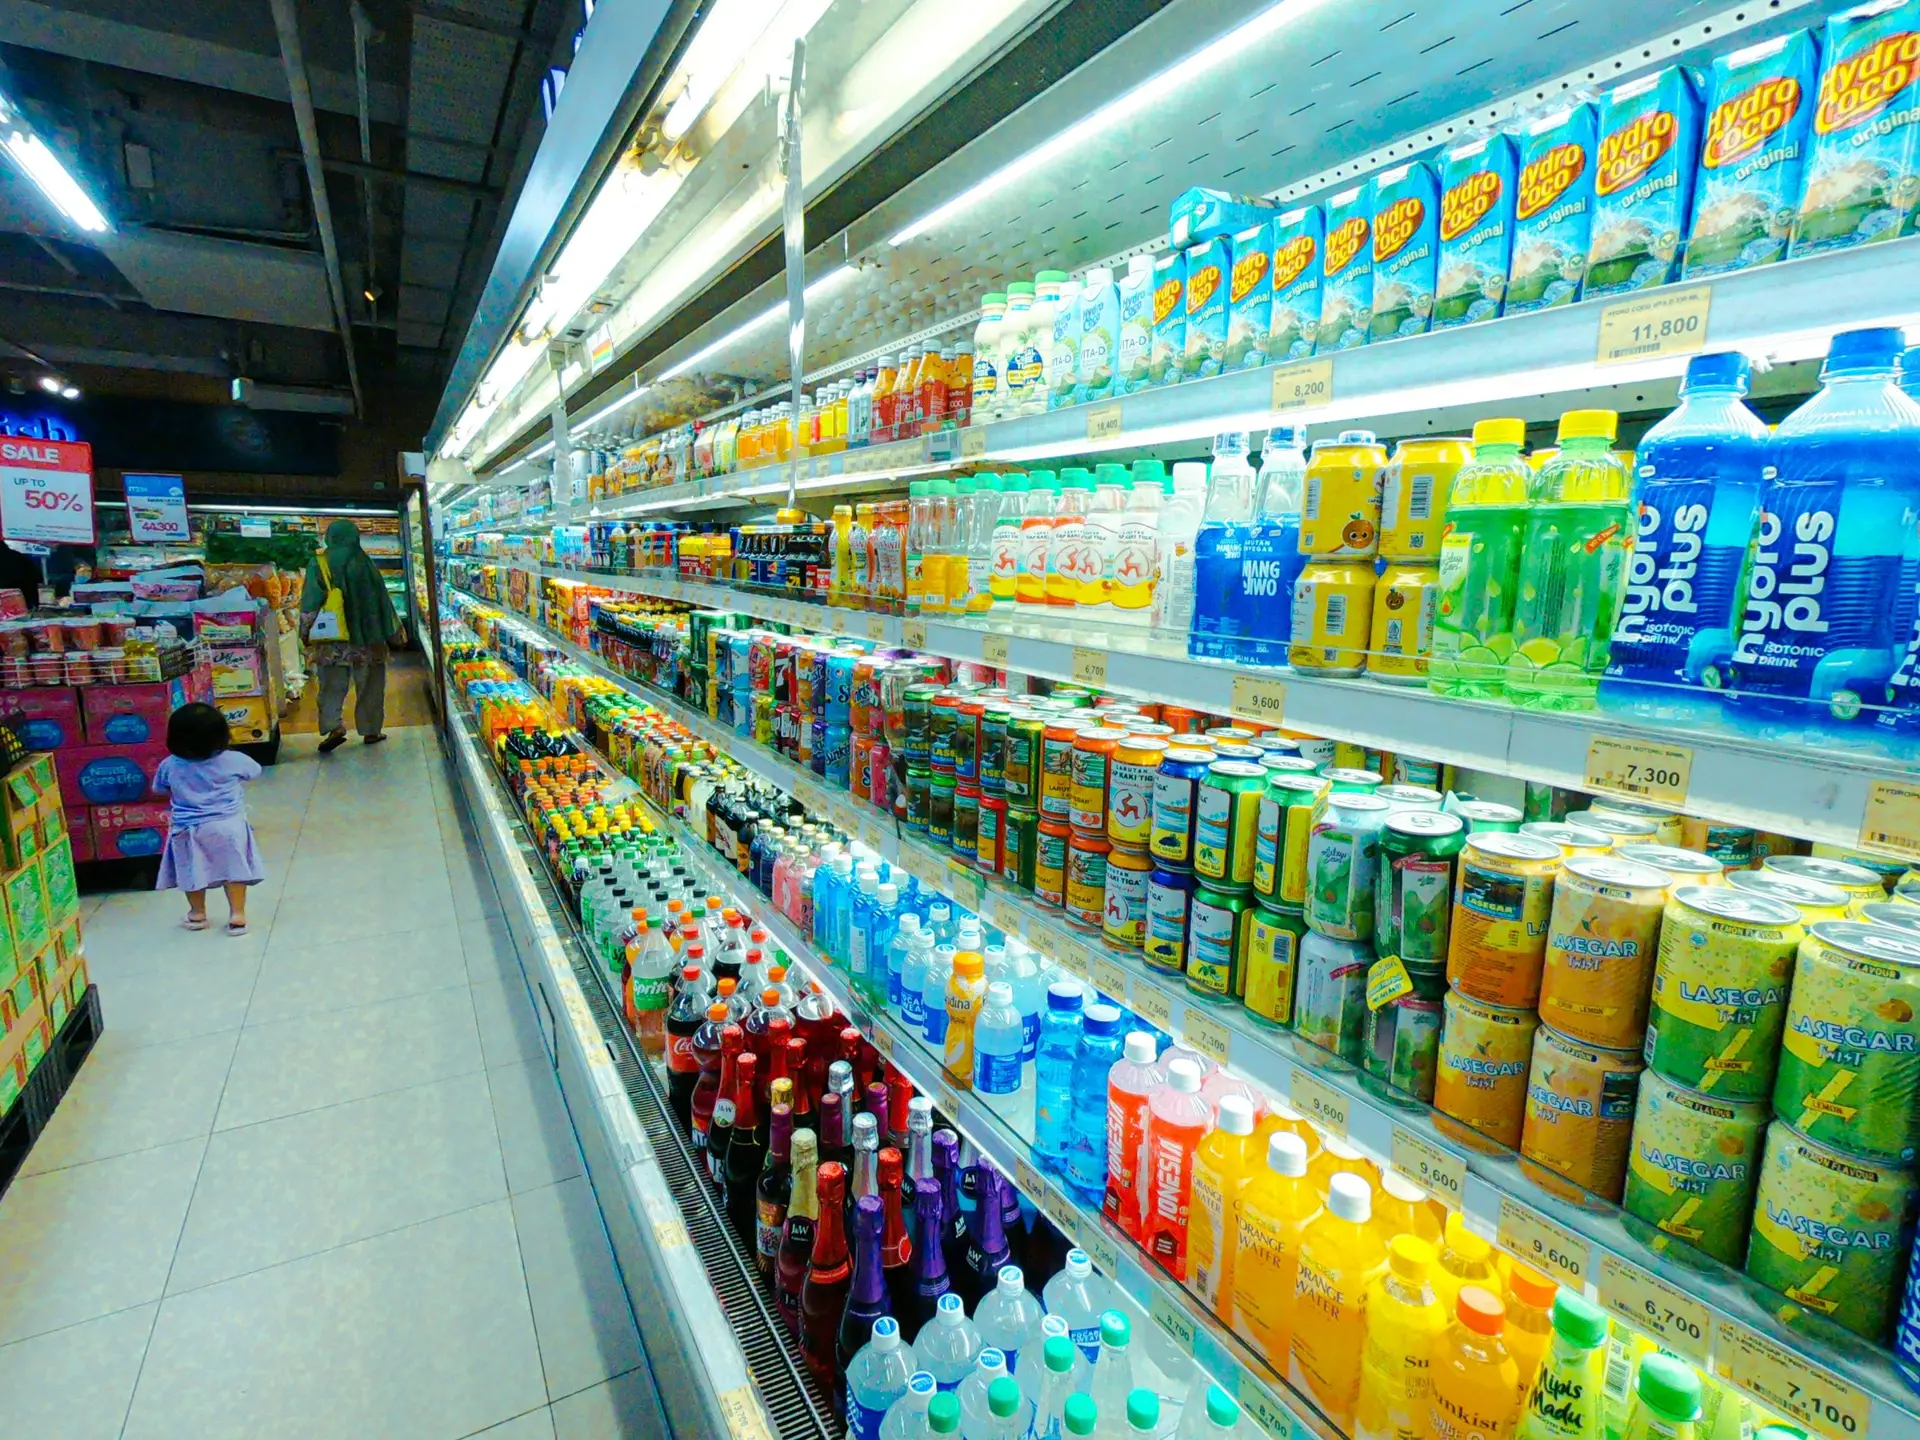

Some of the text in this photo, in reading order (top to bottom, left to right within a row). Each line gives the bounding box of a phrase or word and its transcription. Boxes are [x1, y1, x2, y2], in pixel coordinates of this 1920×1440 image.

[1707, 78, 1798, 140] Hydro
[1598, 112, 1672, 168] Hydro
[1703, 105, 1782, 169] Coco
[1519, 144, 1579, 190] Hydro
[1595, 139, 1660, 196] Coco
[1735, 141, 1799, 181] original
[1517, 169, 1569, 220] Coco
[1620, 169, 1678, 208] original
[1441, 195, 1488, 241] Coco
[1538, 197, 1587, 232] original
[1459, 221, 1503, 253] original
[1336, 261, 1371, 286] original
[1389, 243, 1429, 274] original
[1154, 279, 1182, 303] ydro
[1188, 266, 1218, 291] ydro
[1284, 277, 1317, 301] original
[1239, 291, 1270, 314] original
[1632, 315, 1698, 341] 11,800
[1052, 355, 1071, 365] ITA-D
[1294, 381, 1324, 396] 8,200
[2, 444, 60, 464] SALE
[13, 477, 46, 487] UP TO
[25, 490, 84, 512] 50%
[1658, 504, 1707, 613] plus
[1778, 510, 1834, 632] plus
[1645, 623, 1695, 636] ISOTONIC
[1758, 655, 1798, 668] DRINK
[1763, 641, 1824, 657] ISOTONIC
[1252, 695, 1280, 711] 9,600
[1049, 785, 1070, 793] LARUT
[1628, 764, 1680, 787] 7,300
[1553, 933, 1638, 958] ASEGAR
[1851, 960, 1898, 979] FLAVOUR
[1201, 1031, 1226, 1054] 7,300
[1791, 1010, 1916, 1051] LASEGAR
[1446, 1050, 1525, 1076] LASEGAR
[1313, 1098, 1344, 1123] 9,600
[1812, 1099, 1845, 1115] LEMON
[1420, 1161, 1458, 1192] 9,600
[1640, 1141, 1746, 1181] LASEGAR
[1192, 1175, 1223, 1202] ORANGE
[1193, 1186, 1222, 1214] WATER
[1238, 1219, 1284, 1253] ORANGE
[1767, 1199, 1892, 1250] LASEGAR
[1239, 1233, 1281, 1270] WATER
[1533, 1239, 1580, 1276] 9,600
[1295, 1277, 1340, 1320] WATER
[1645, 1300, 1701, 1340] 6,700
[1538, 1361, 1584, 1400] Nipis
[1528, 1385, 1585, 1428] Madu
[1786, 1381, 1857, 1433] 7,100
